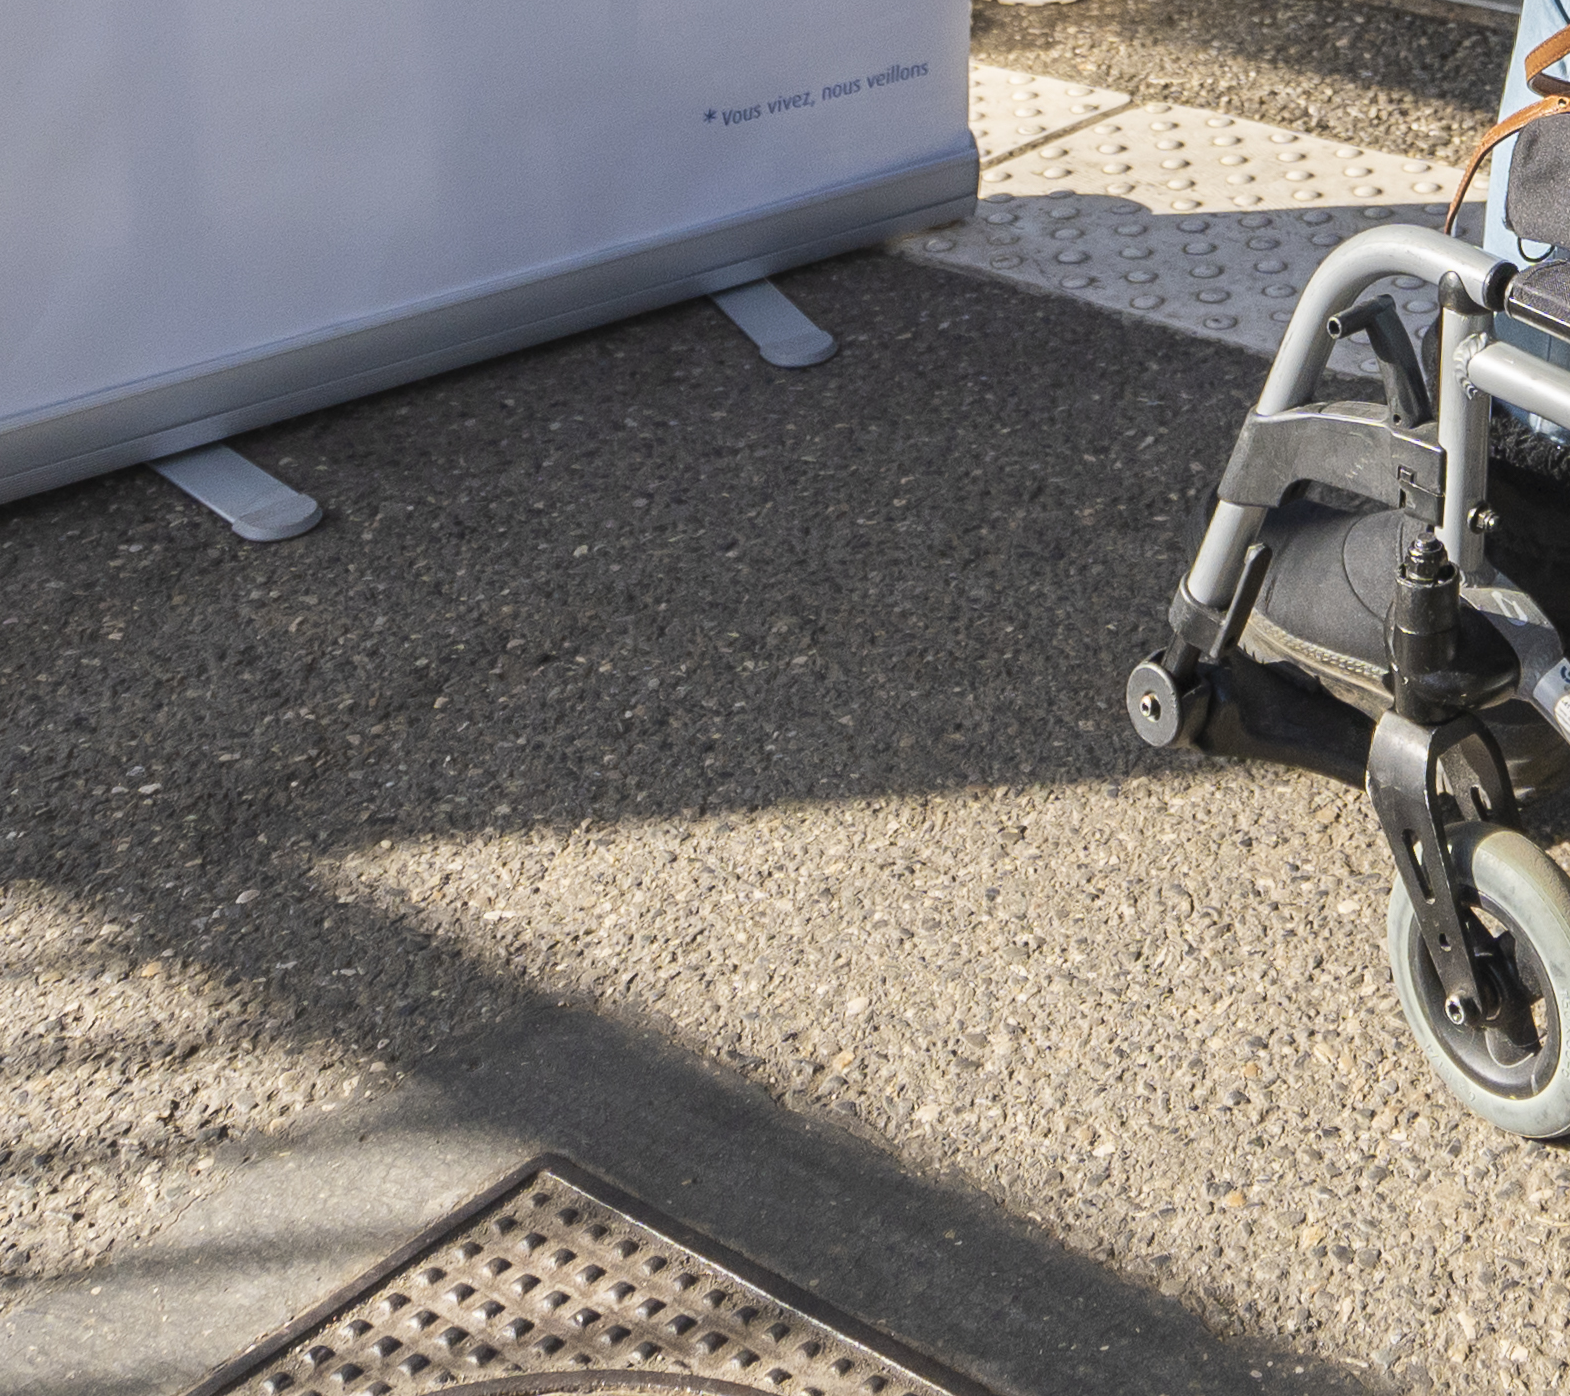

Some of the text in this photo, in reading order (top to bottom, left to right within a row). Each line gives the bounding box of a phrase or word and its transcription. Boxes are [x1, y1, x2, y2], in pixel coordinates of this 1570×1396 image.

[722, 62, 929, 126] Vous vivez, nous veillons
